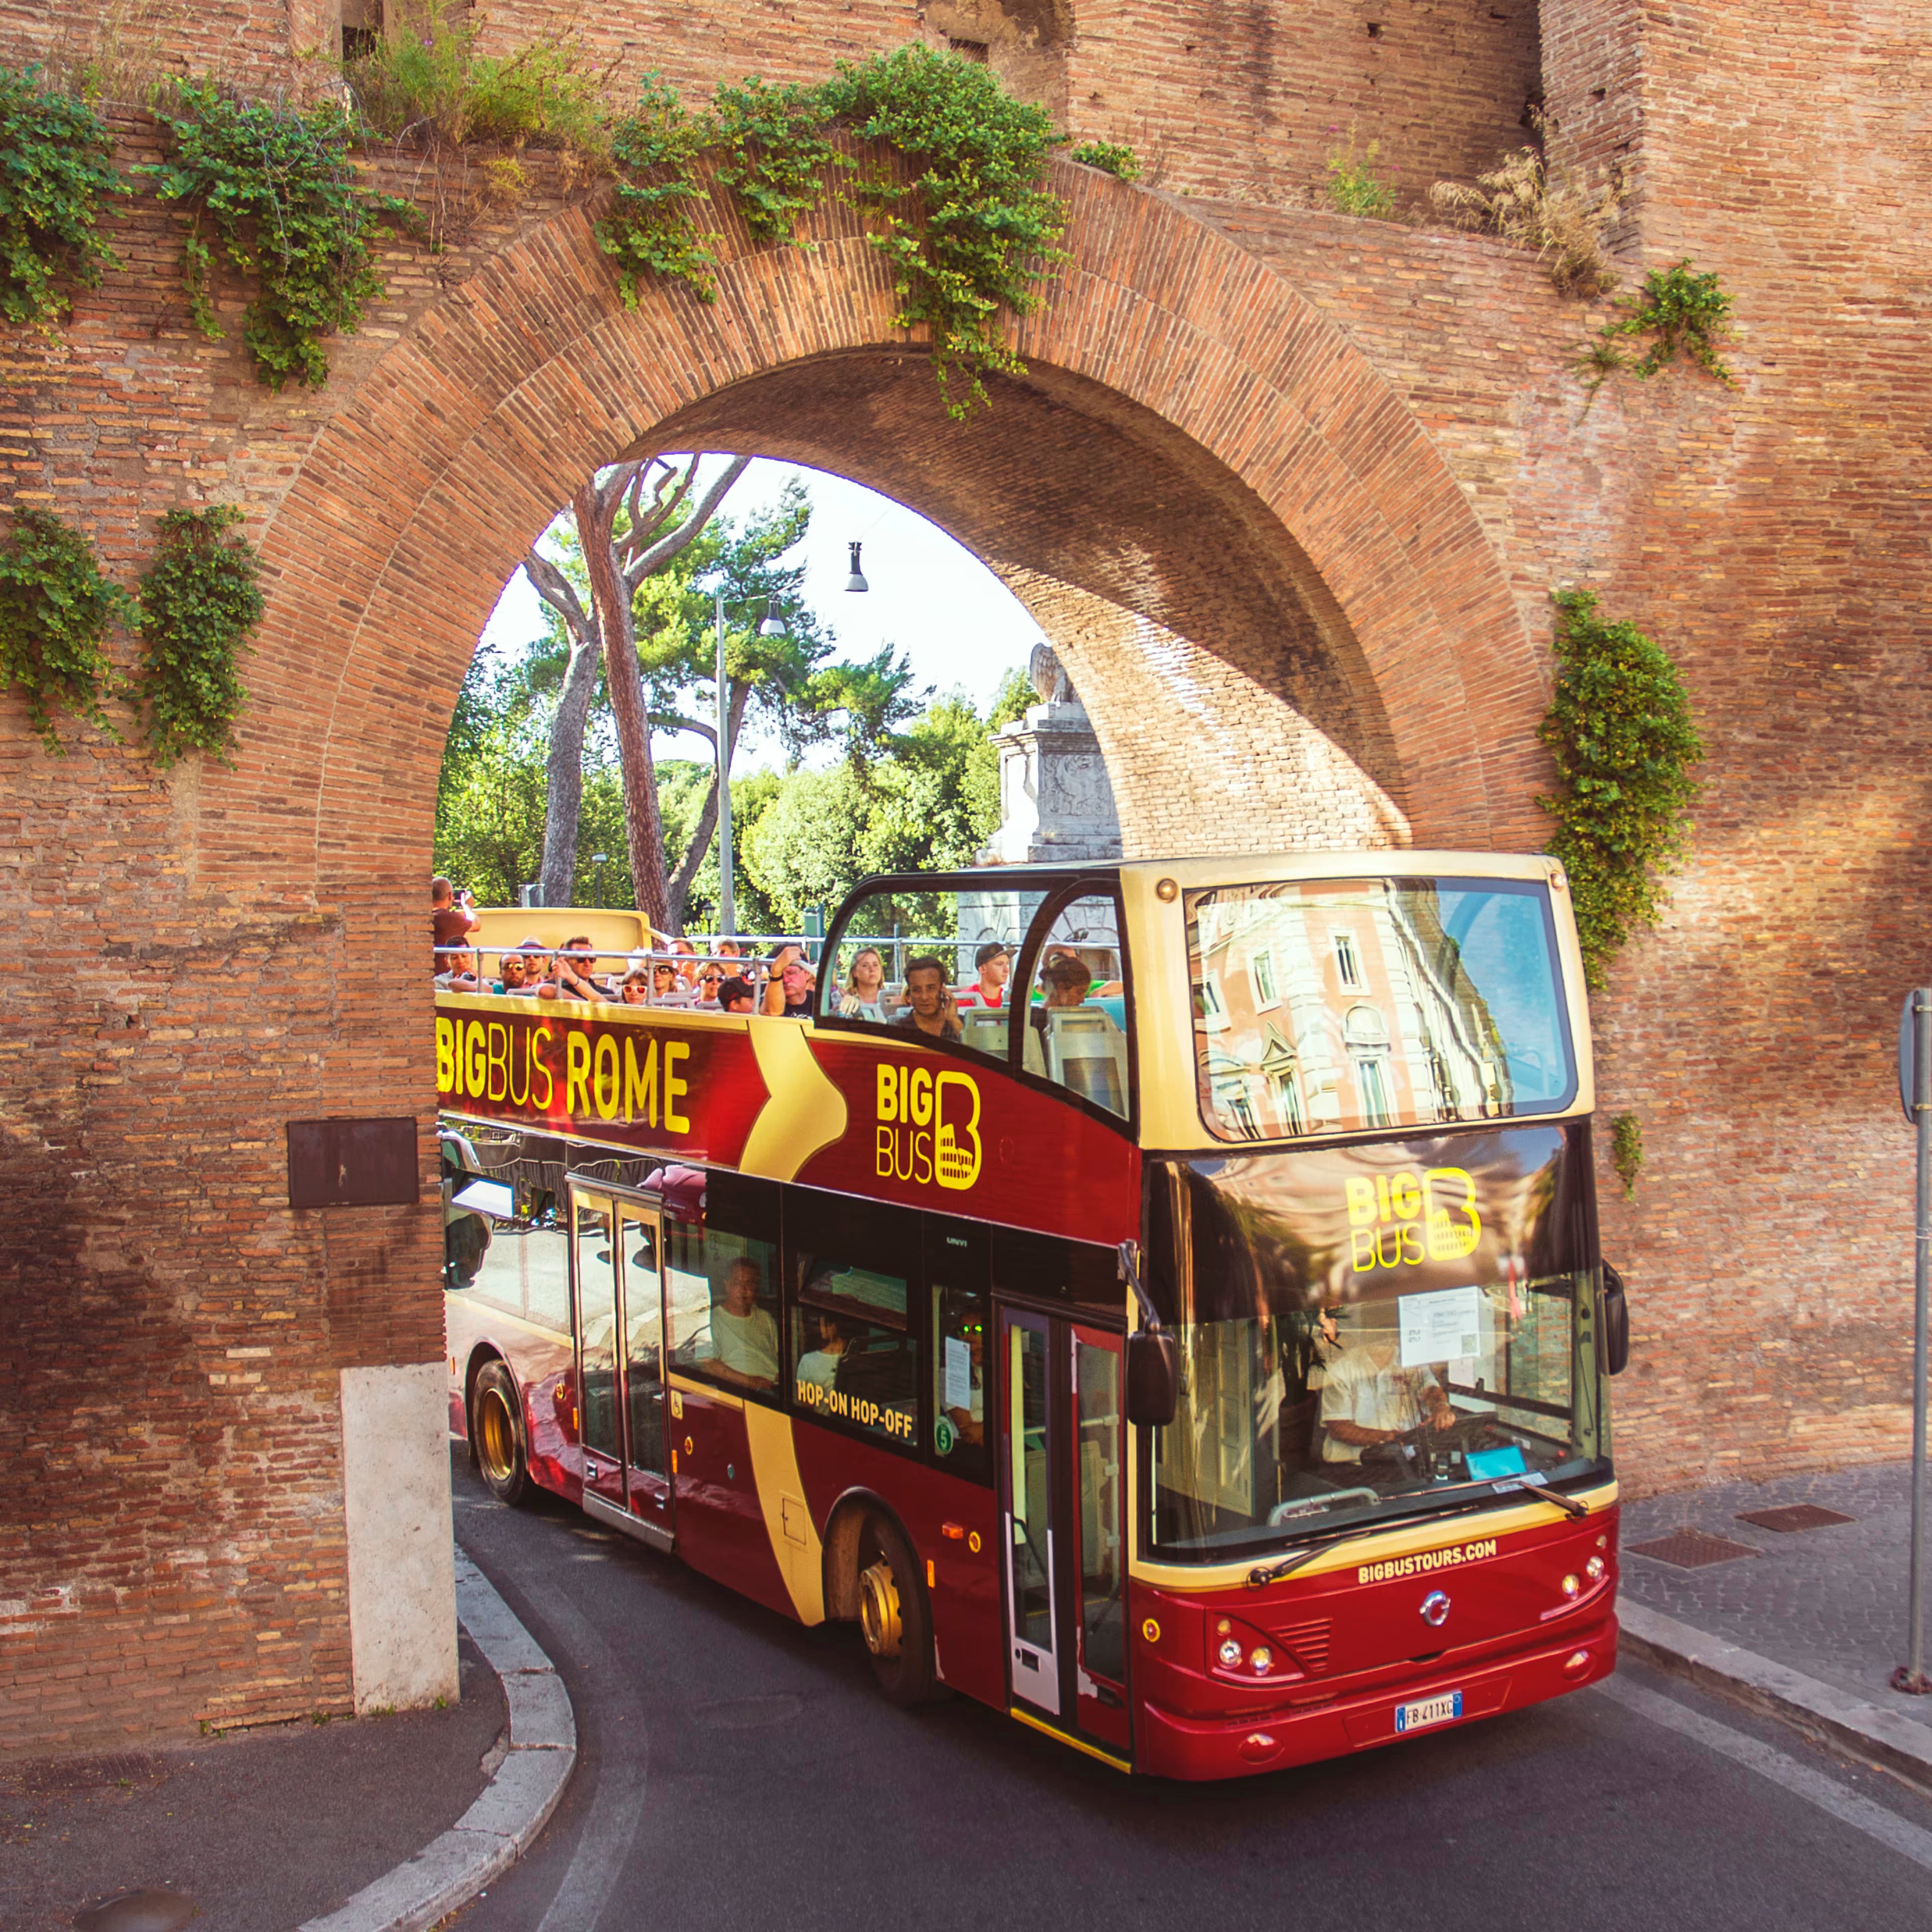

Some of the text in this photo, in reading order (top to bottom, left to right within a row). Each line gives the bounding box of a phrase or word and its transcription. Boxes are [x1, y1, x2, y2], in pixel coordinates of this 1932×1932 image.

[567, 1030, 690, 1134] ROME
[877, 1064, 933, 1126] BIG
[876, 1126, 932, 1184] BUS
[1345, 1172, 1421, 1226] BIG
[1351, 1223, 1425, 1272] BUS
[797, 1380, 913, 1438] HOP-ON HOP-OFF
[940, 1429, 948, 1450] 5
[1358, 1540, 1497, 1584] BIGBUSTOURS.COM
